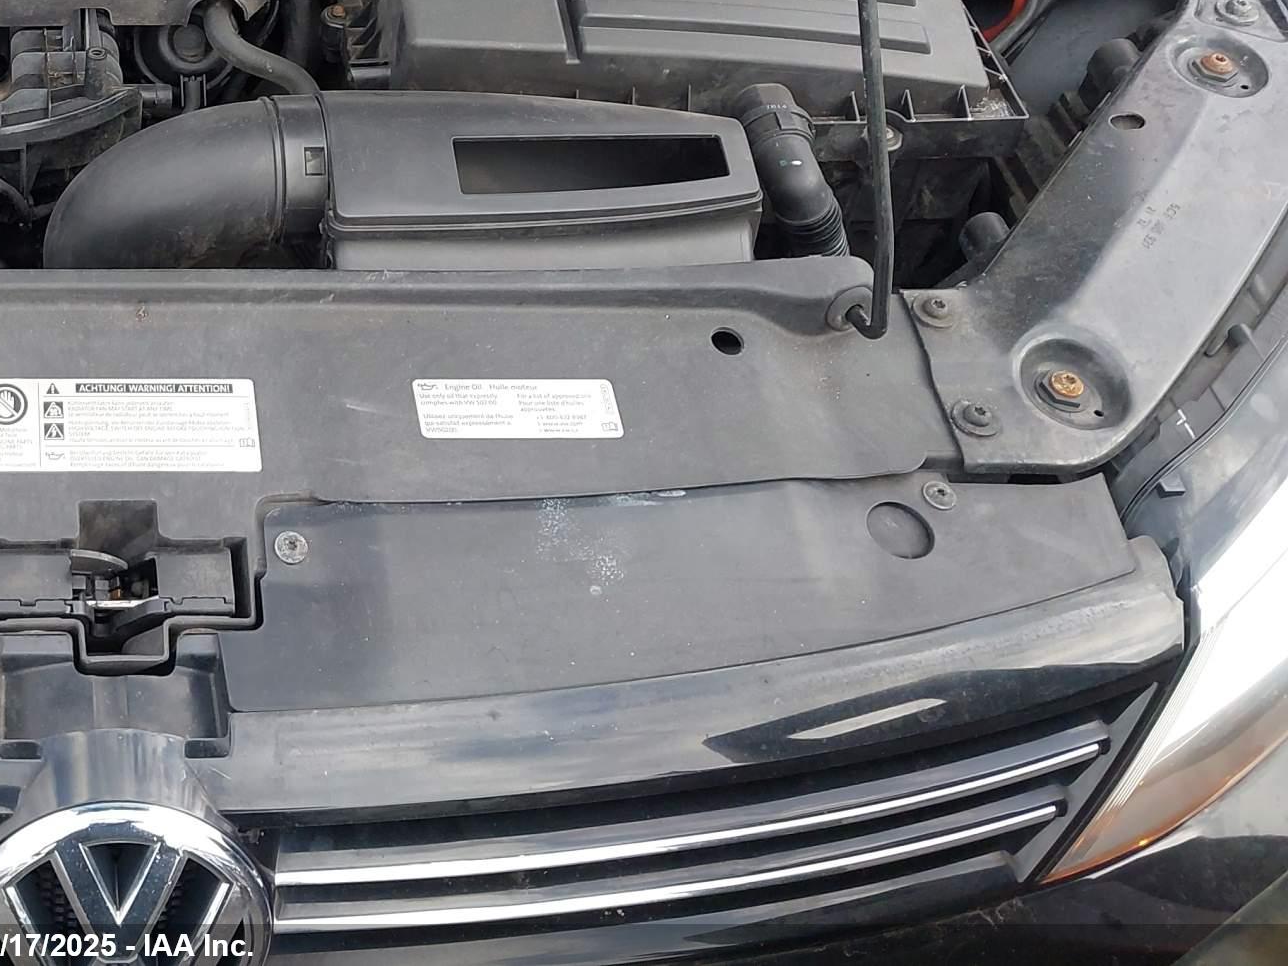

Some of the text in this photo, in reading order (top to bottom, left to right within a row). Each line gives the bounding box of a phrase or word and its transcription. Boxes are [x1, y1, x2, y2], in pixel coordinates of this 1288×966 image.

[79, 384, 231, 394] ACHTUNG! WARNING! ATTENTION!
